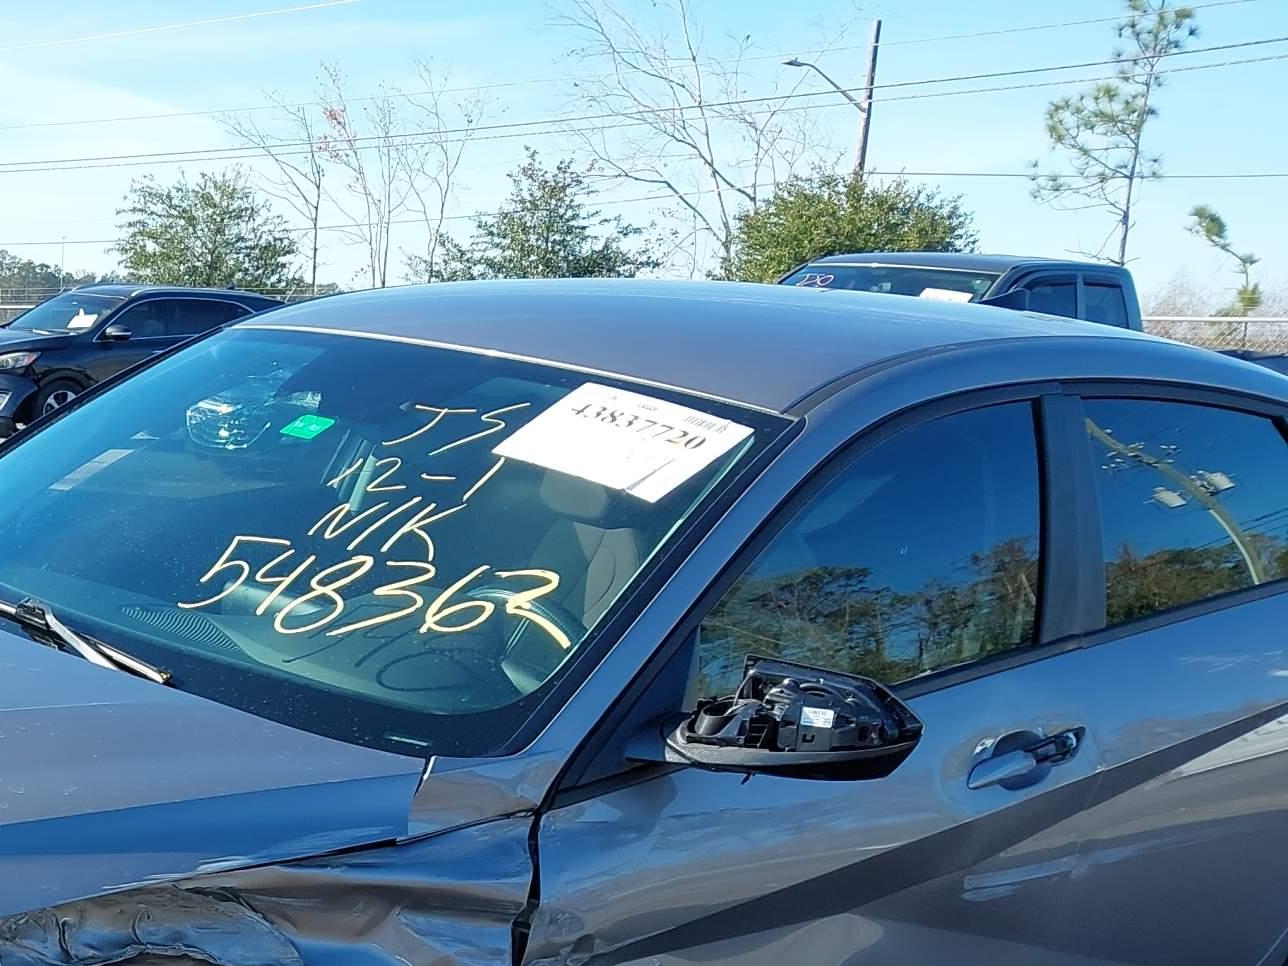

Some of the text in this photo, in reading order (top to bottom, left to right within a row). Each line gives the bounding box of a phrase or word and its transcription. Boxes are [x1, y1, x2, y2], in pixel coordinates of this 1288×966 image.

[571, 403, 707, 450] 43837720
[327, 457, 506, 503] 12-1
[178, 535, 572, 650] 548362
